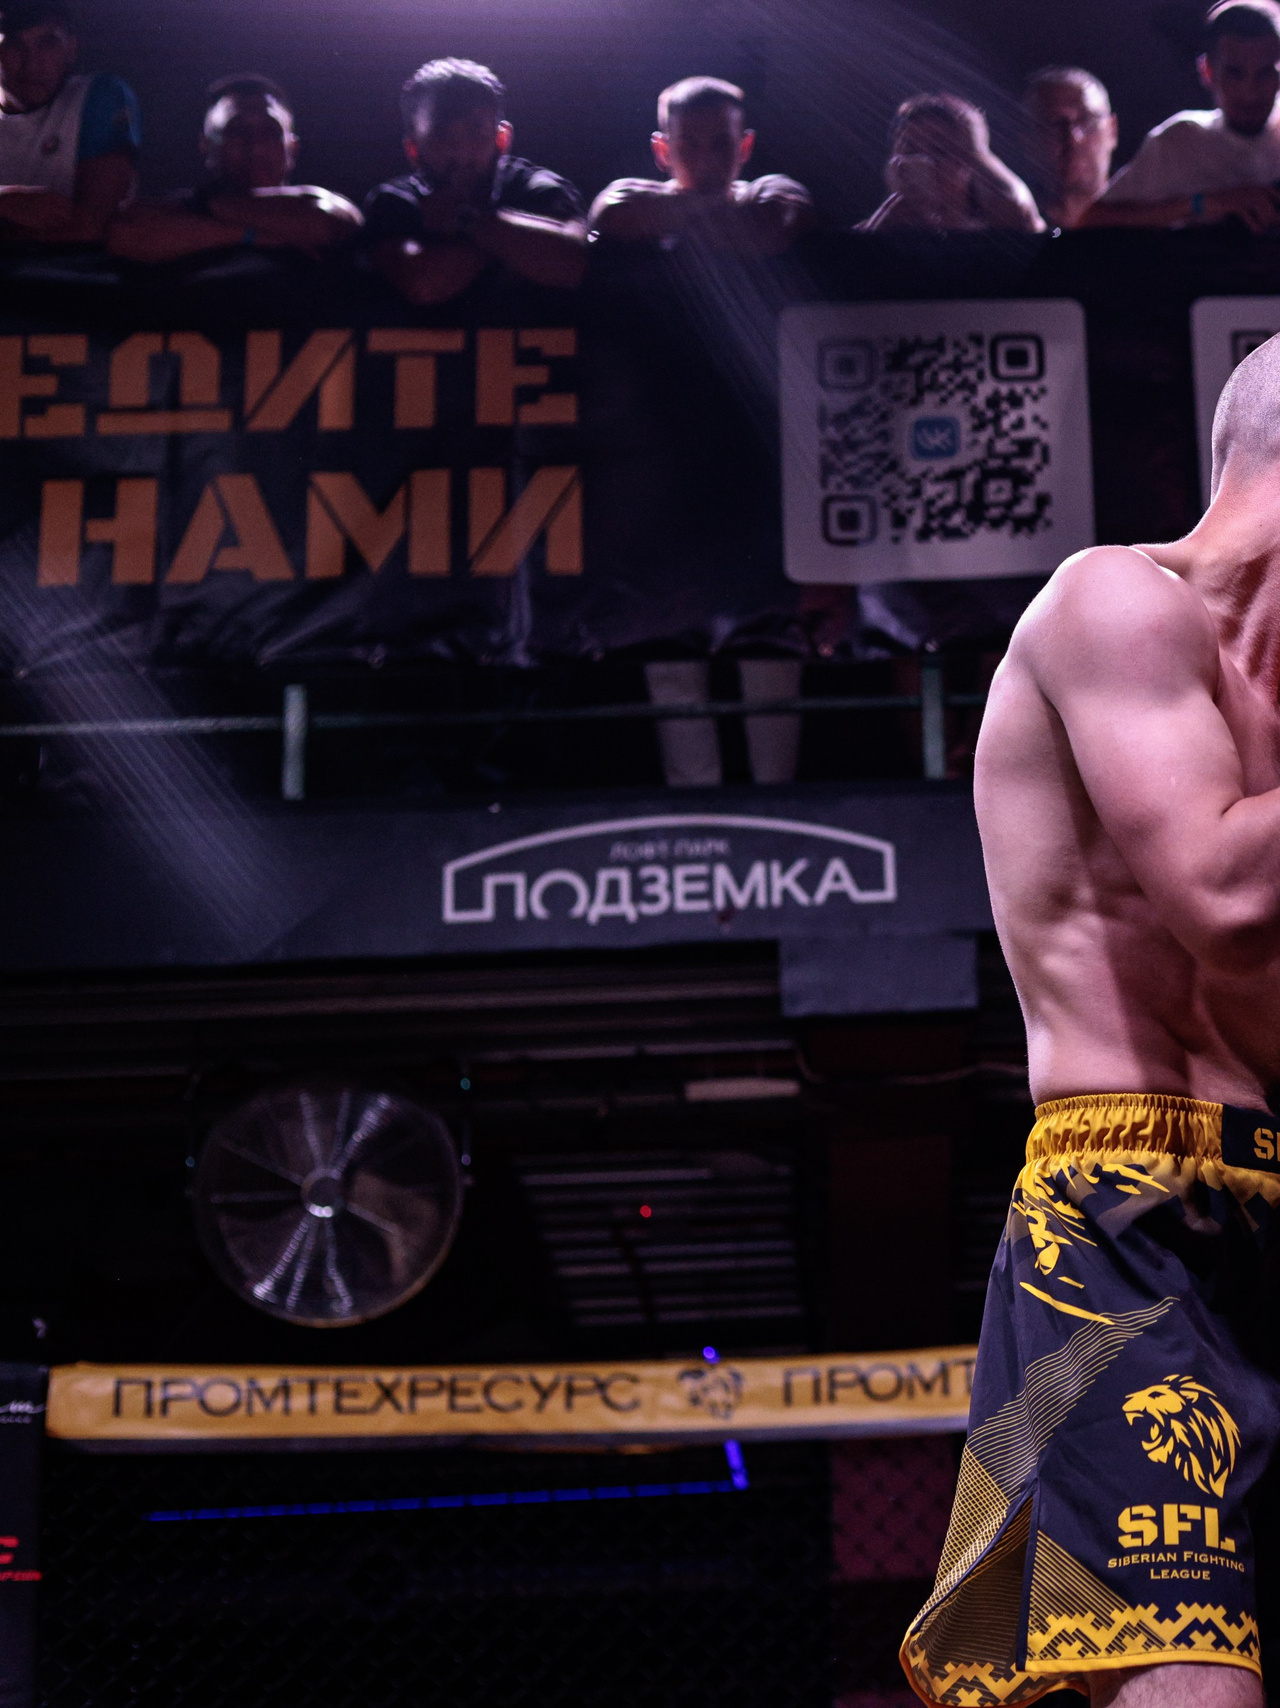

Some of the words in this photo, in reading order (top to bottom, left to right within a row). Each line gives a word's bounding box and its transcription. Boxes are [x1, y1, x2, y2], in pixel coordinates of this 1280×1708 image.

[38, 466, 584, 586] НАМИ
[484, 859, 857, 924] ПОДЗЕМКА
[112, 1373, 642, 1418] ПРОМТЕХРЕСУРС
[1118, 1503, 1236, 1553] SFL
[1107, 1552, 1177, 1568] SIBERIAN
[1183, 1551, 1245, 1573] FIGHTING
[1150, 1568, 1211, 1581] LEAGUE
